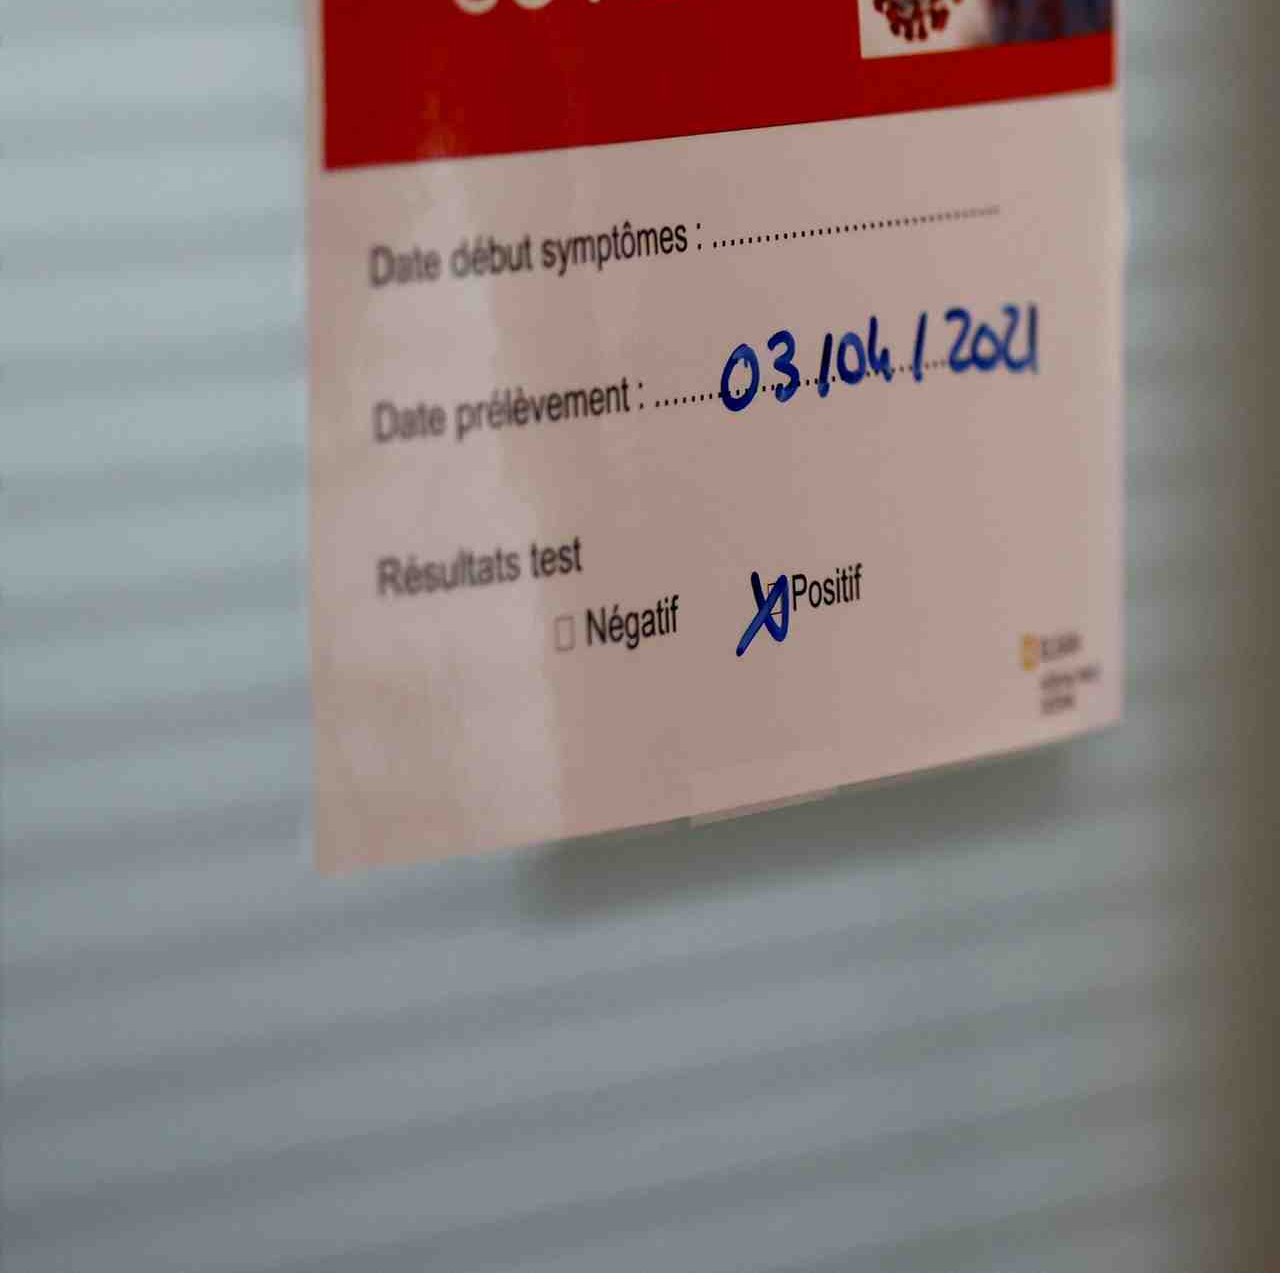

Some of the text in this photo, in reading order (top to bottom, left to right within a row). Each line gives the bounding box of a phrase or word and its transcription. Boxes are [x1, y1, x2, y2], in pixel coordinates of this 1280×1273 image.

[370, 249, 440, 289] Date
[449, 231, 533, 277] début
[542, 222, 688, 276] symptômes
[374, 404, 447, 444] Date
[456, 377, 631, 441] prélèvement
[377, 537, 582, 599] Résultats test
[791, 563, 863, 612] Positif
[585, 594, 679, 648] Négatif
